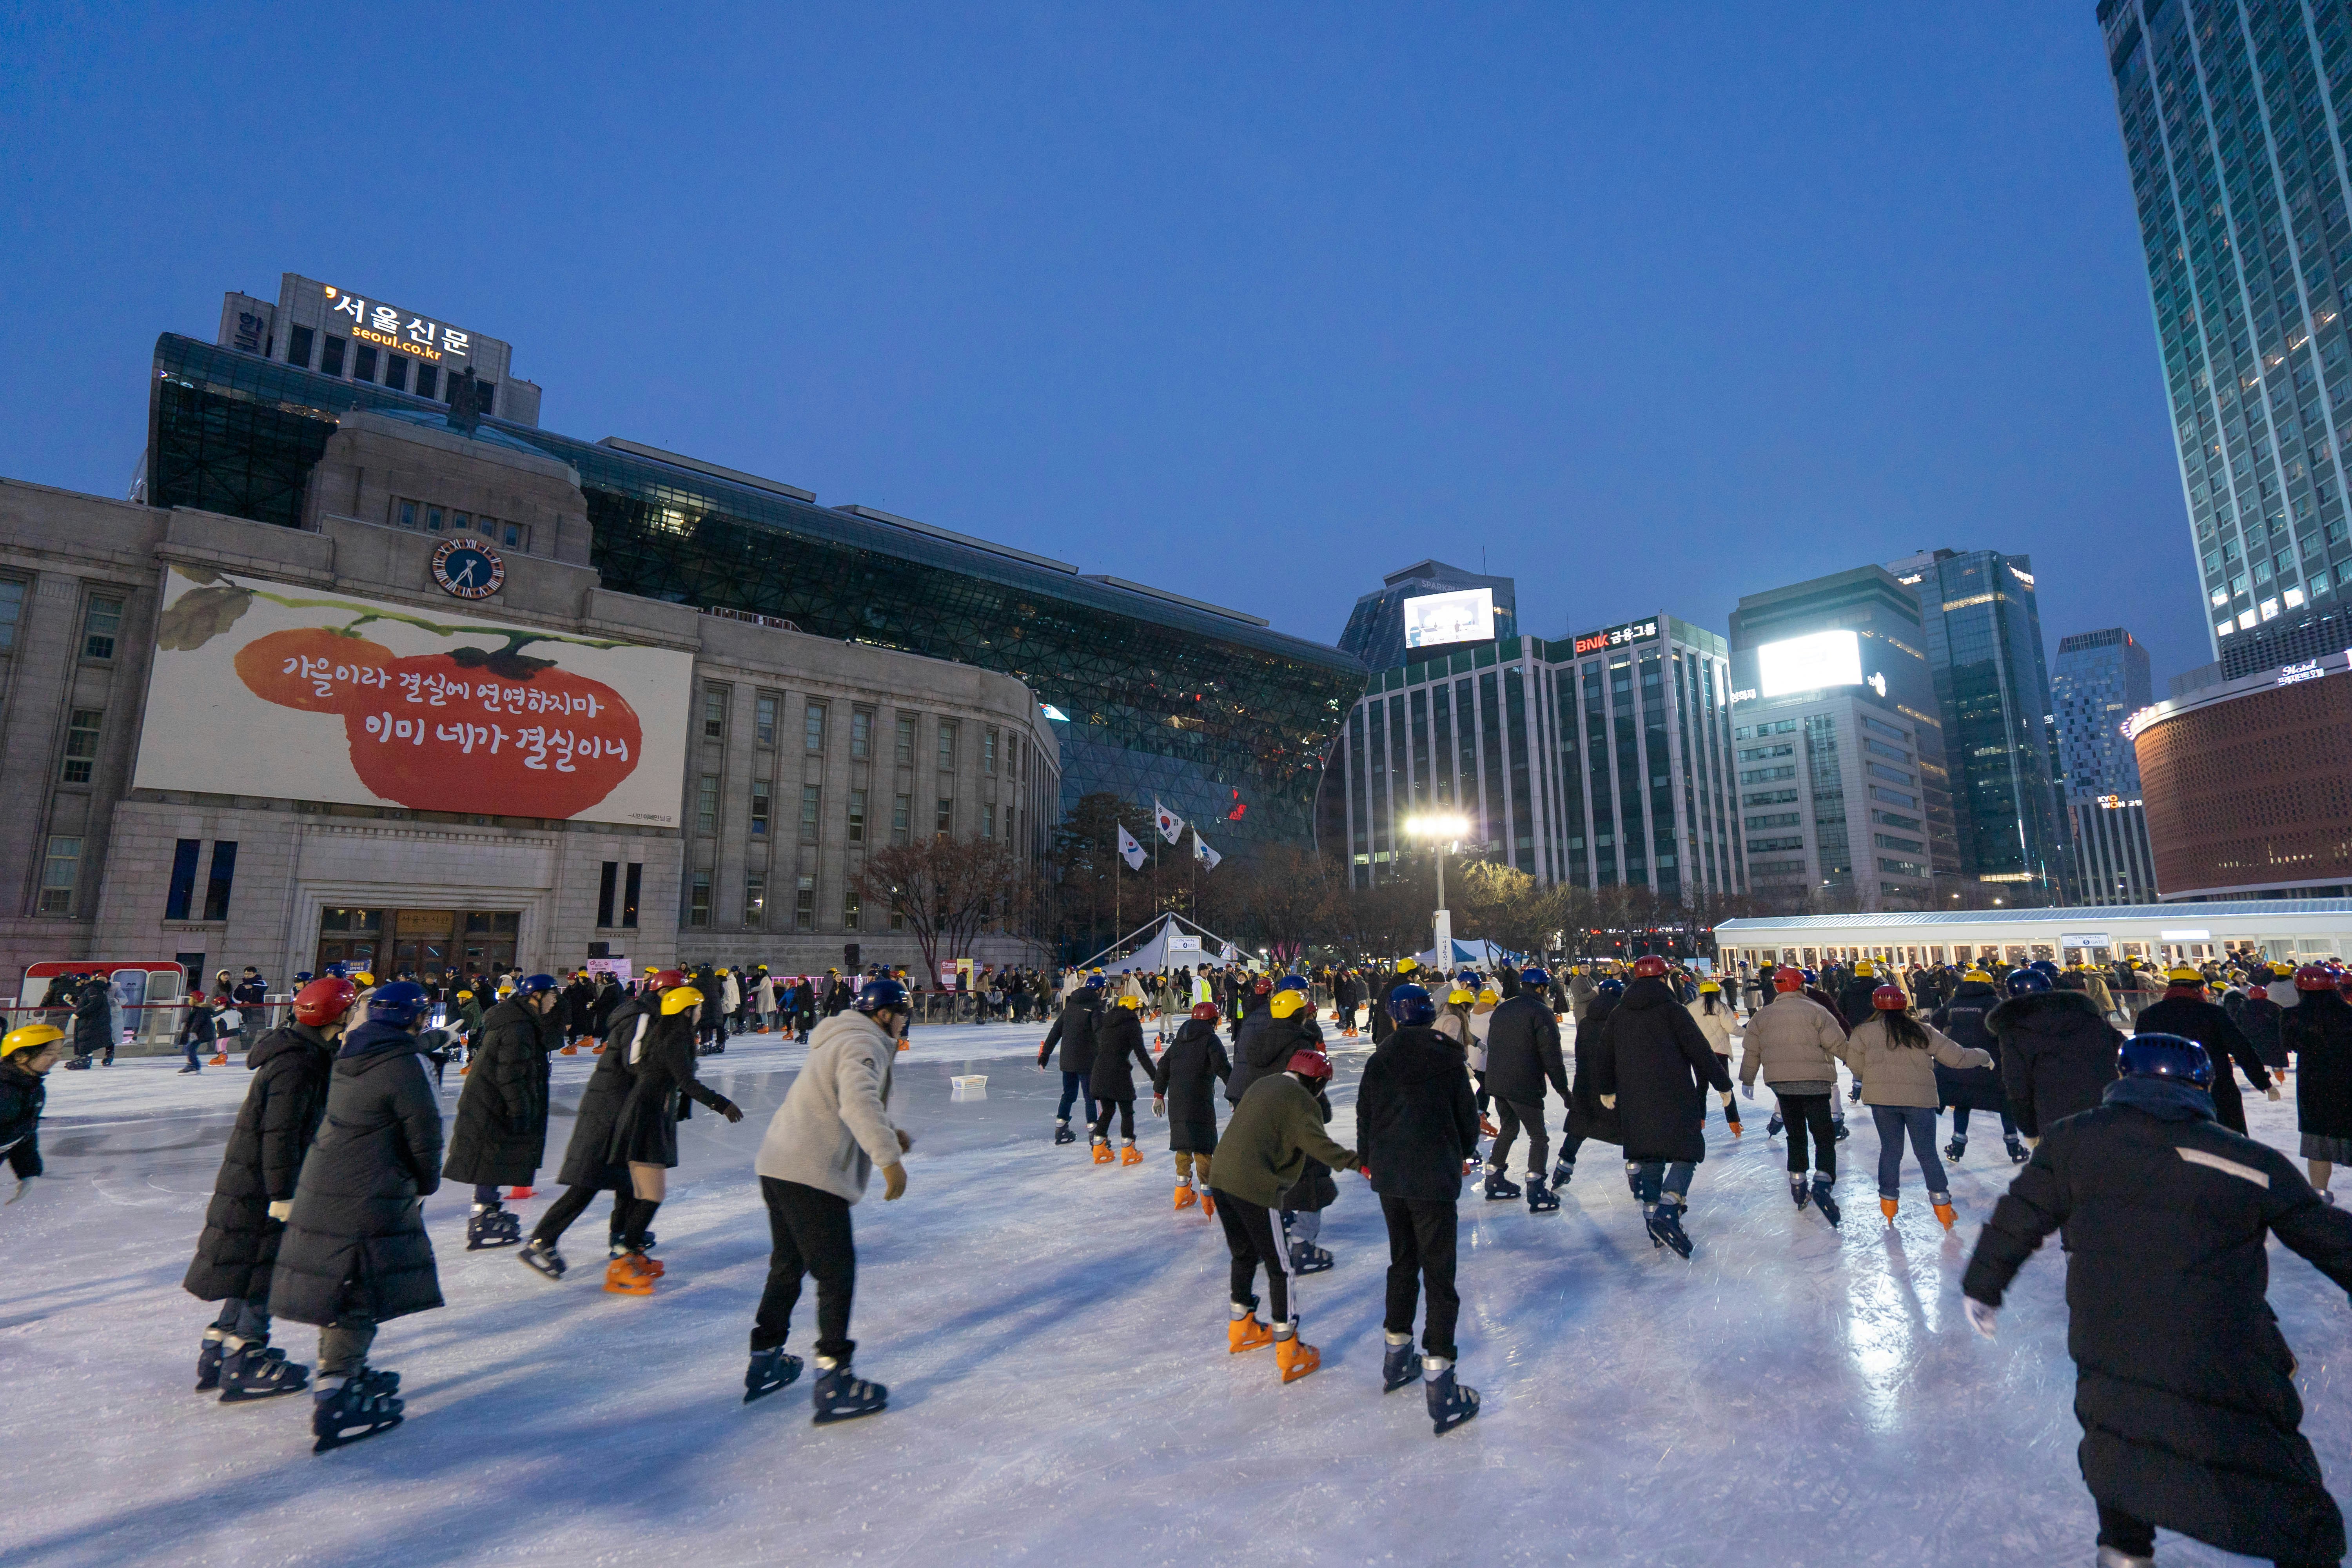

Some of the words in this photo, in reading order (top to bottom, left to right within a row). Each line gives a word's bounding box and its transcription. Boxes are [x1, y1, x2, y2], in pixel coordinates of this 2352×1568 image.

[352, 326, 442, 361] seoul.co.kr
[1576, 634, 1610, 653] BNK
[1610, 622, 1657, 644] 금융그룹
[2278, 668, 2325, 686] 프레지던트호텔
[2283, 659, 2318, 677] Hotel
[283, 655, 392, 697] 가을이라
[399, 673, 470, 706] 결실에
[477, 683, 605, 718] 연연하지마
[366, 711, 425, 745] 이미
[436, 723, 510, 754] 네가
[516, 726, 628, 772] 결실이니
[2097, 795, 2118, 803] KYO
[2101, 800, 2125, 809] WON
